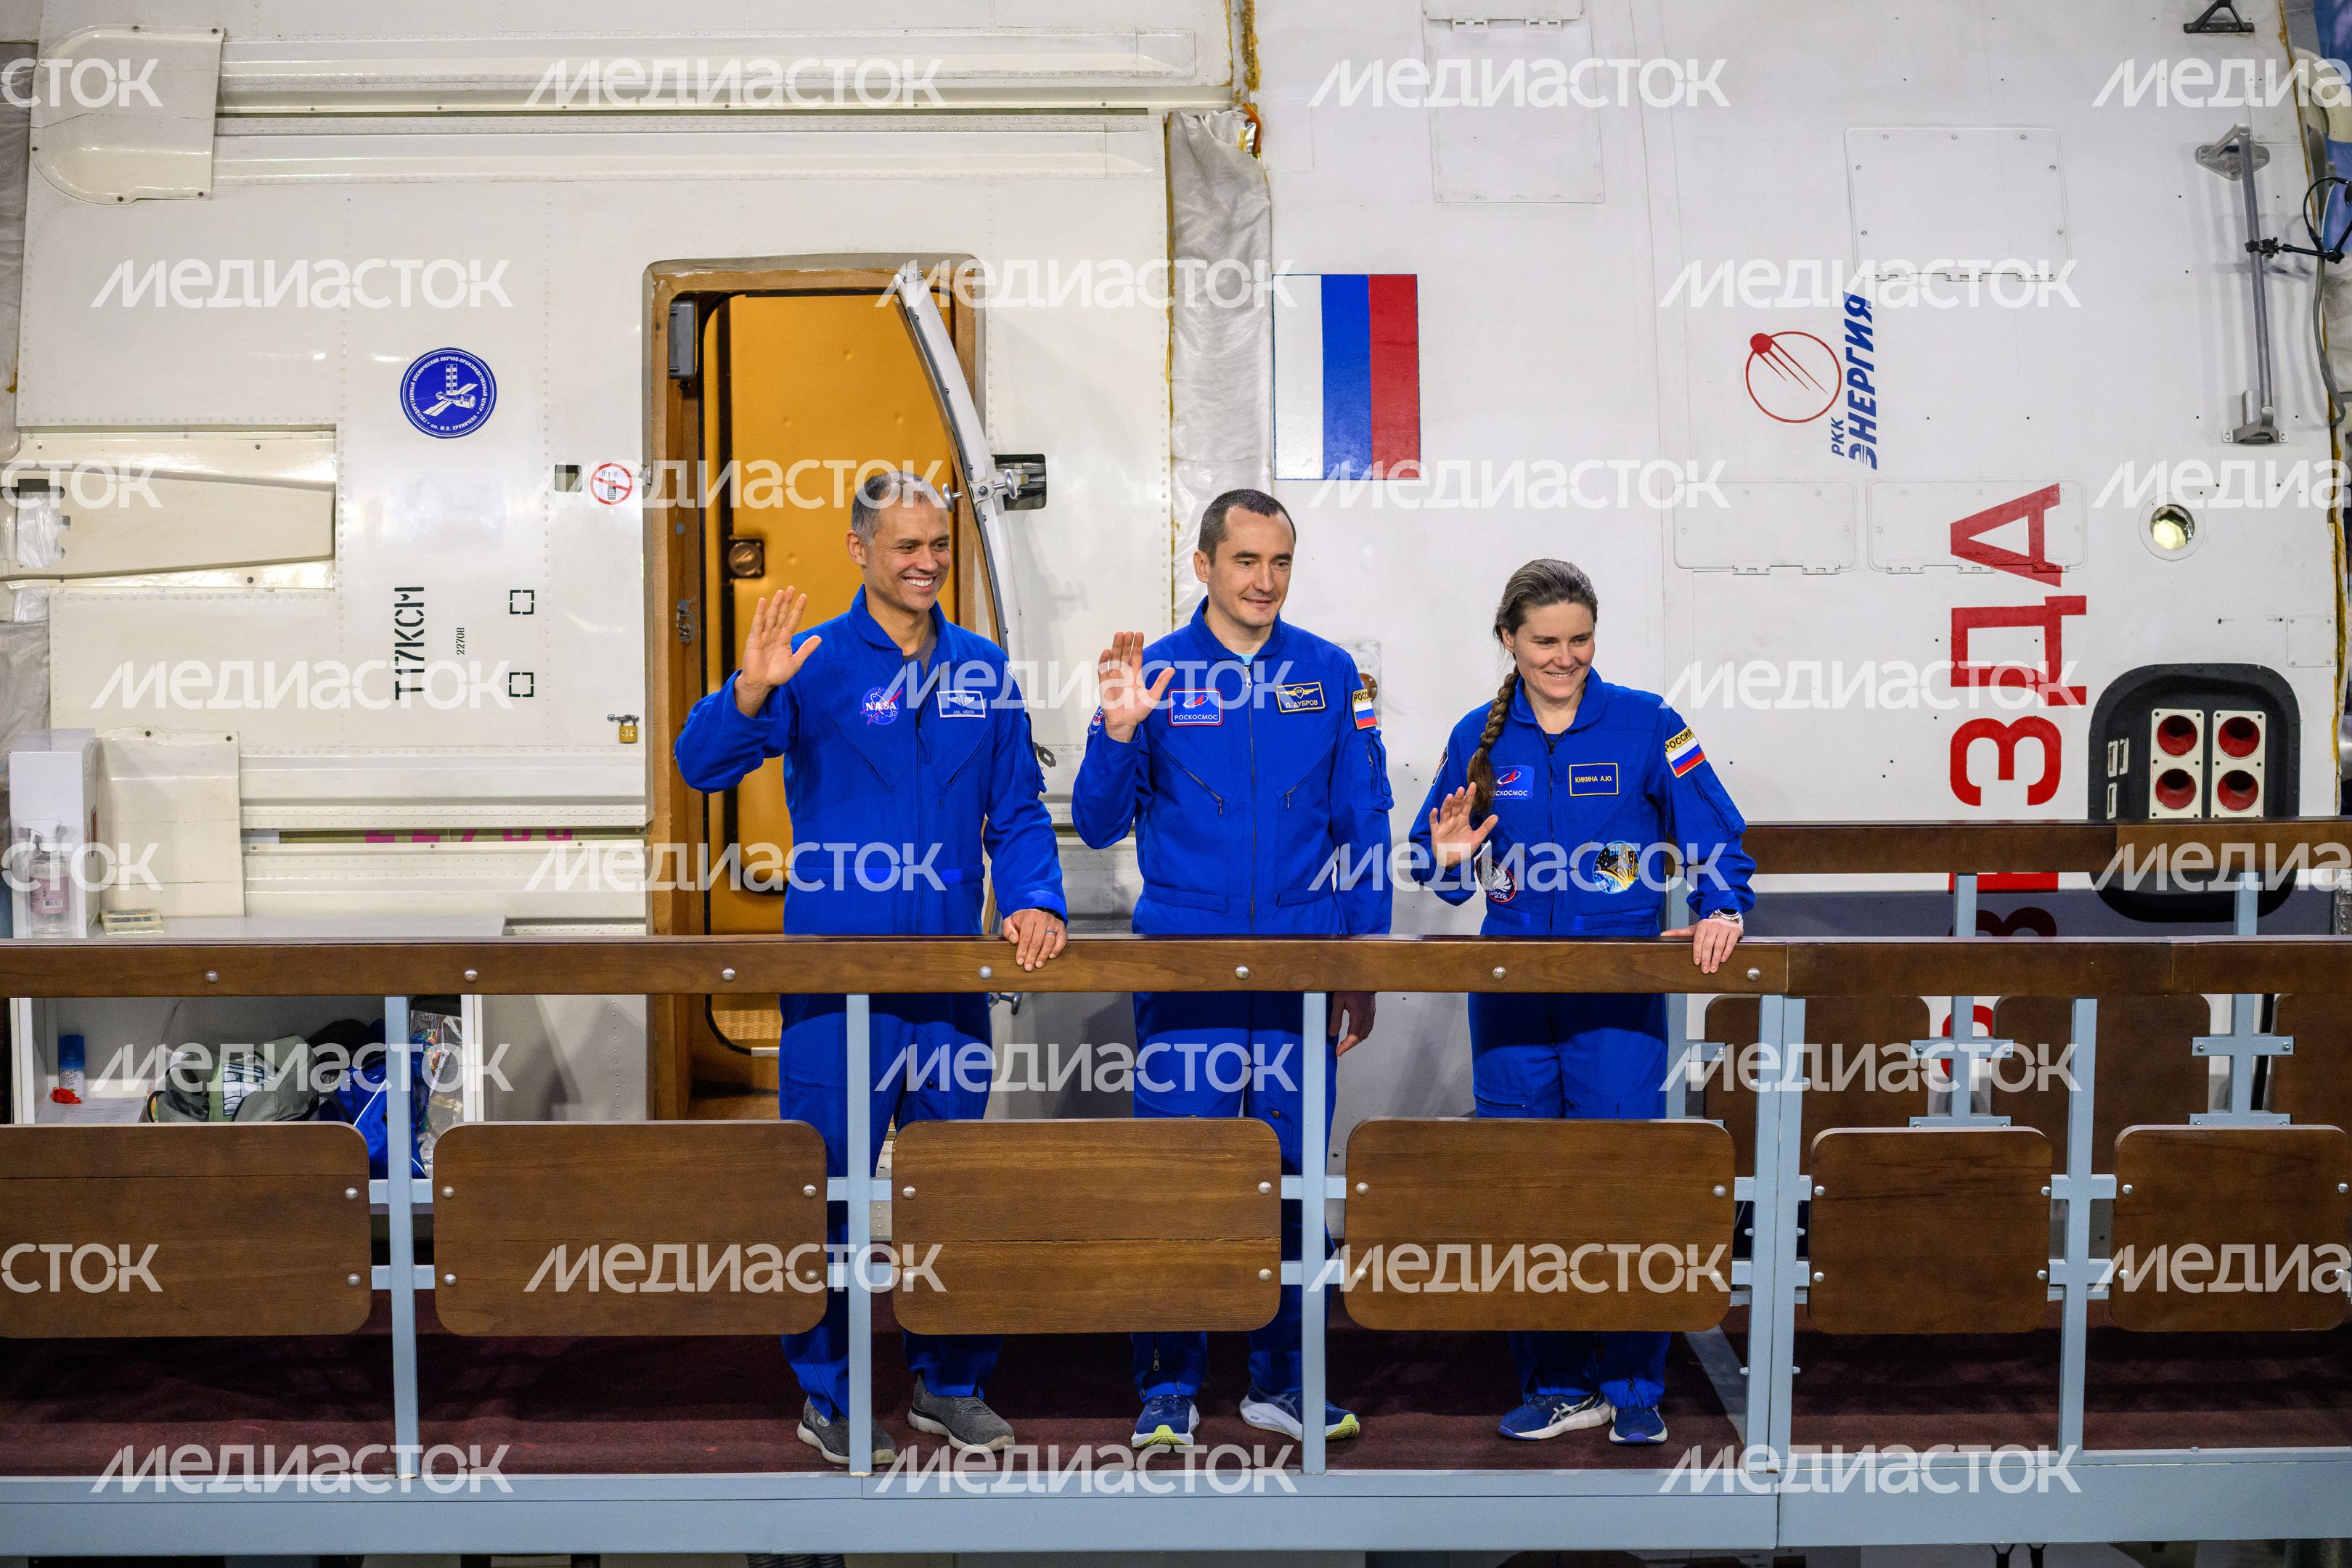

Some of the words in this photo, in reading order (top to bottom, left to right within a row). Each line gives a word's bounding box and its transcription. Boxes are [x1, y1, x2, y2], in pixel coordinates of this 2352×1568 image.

[1843, 291, 1877, 470] ЭНЕРГИЯ
[1831, 417, 1845, 457] РКК
[456, 627, 465, 656] 22708
[865, 701, 897, 711] NASA
[1294, 699, 1318, 709] ДУБРОВ
